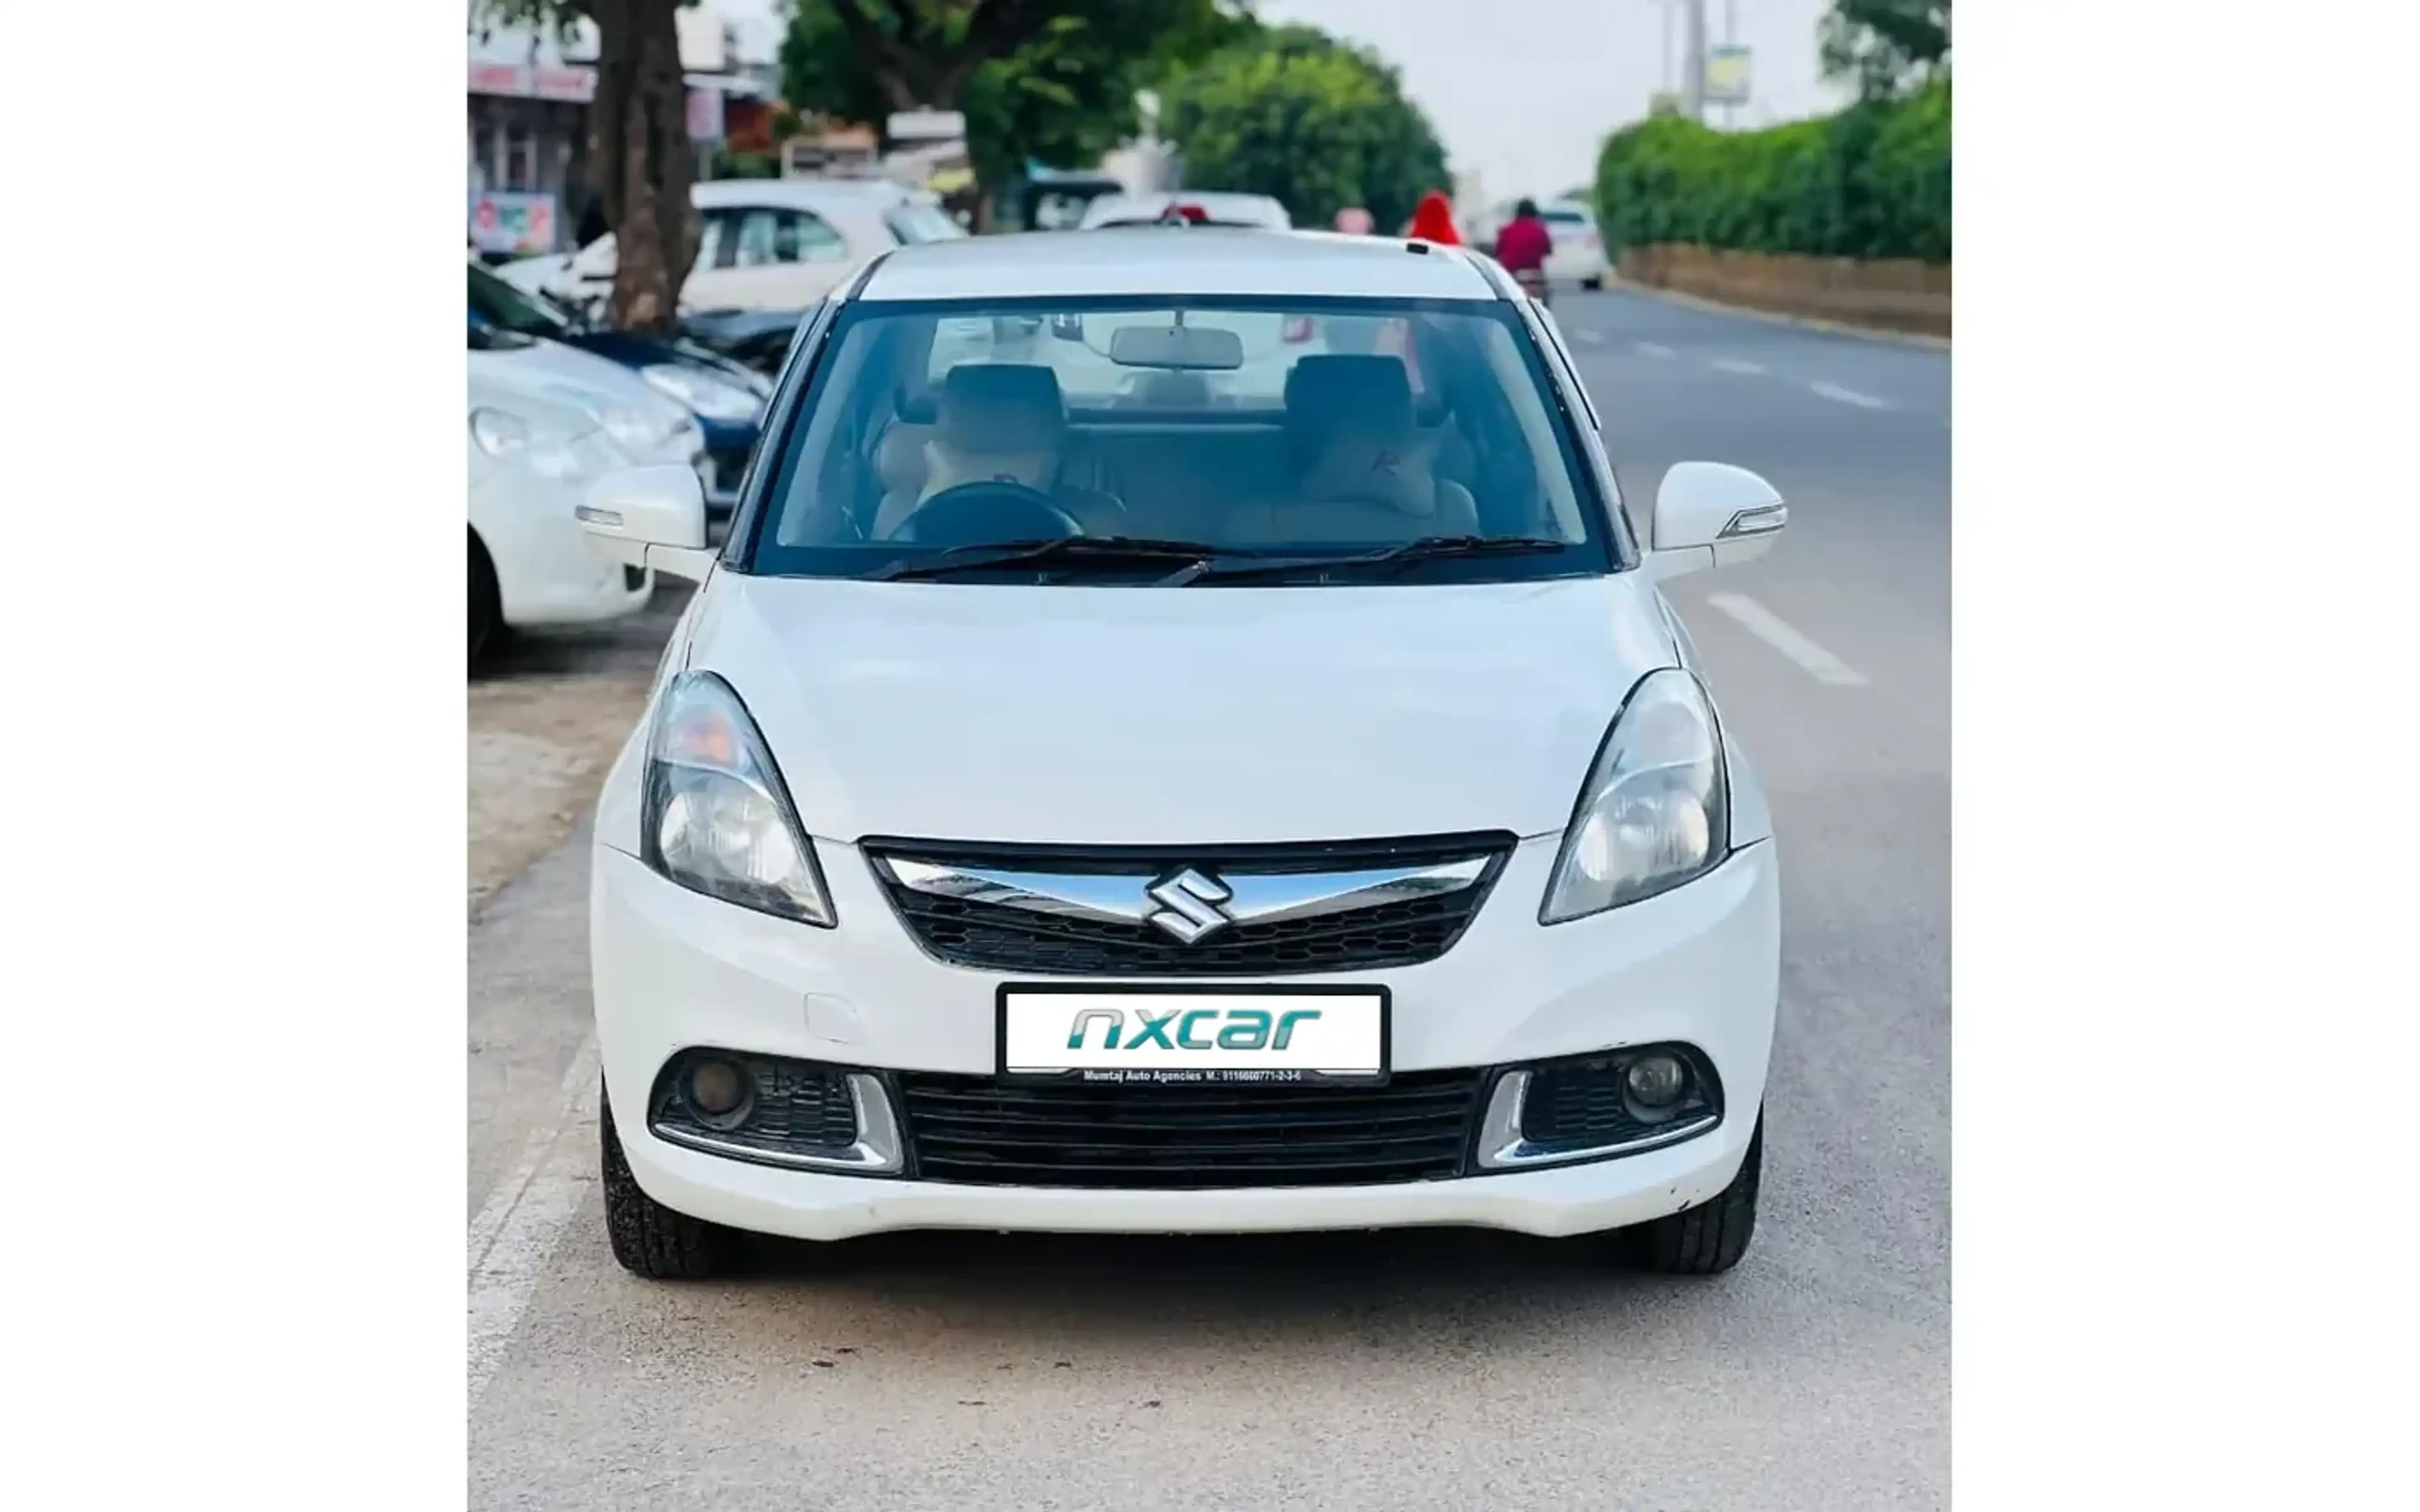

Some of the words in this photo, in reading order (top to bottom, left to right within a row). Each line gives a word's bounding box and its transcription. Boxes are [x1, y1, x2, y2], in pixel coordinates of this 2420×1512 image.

[1083, 1070, 1123, 1084] Mumtaj
[1126, 1070, 1151, 1081] Auto
[1153, 1070, 1202, 1083] Agencies
